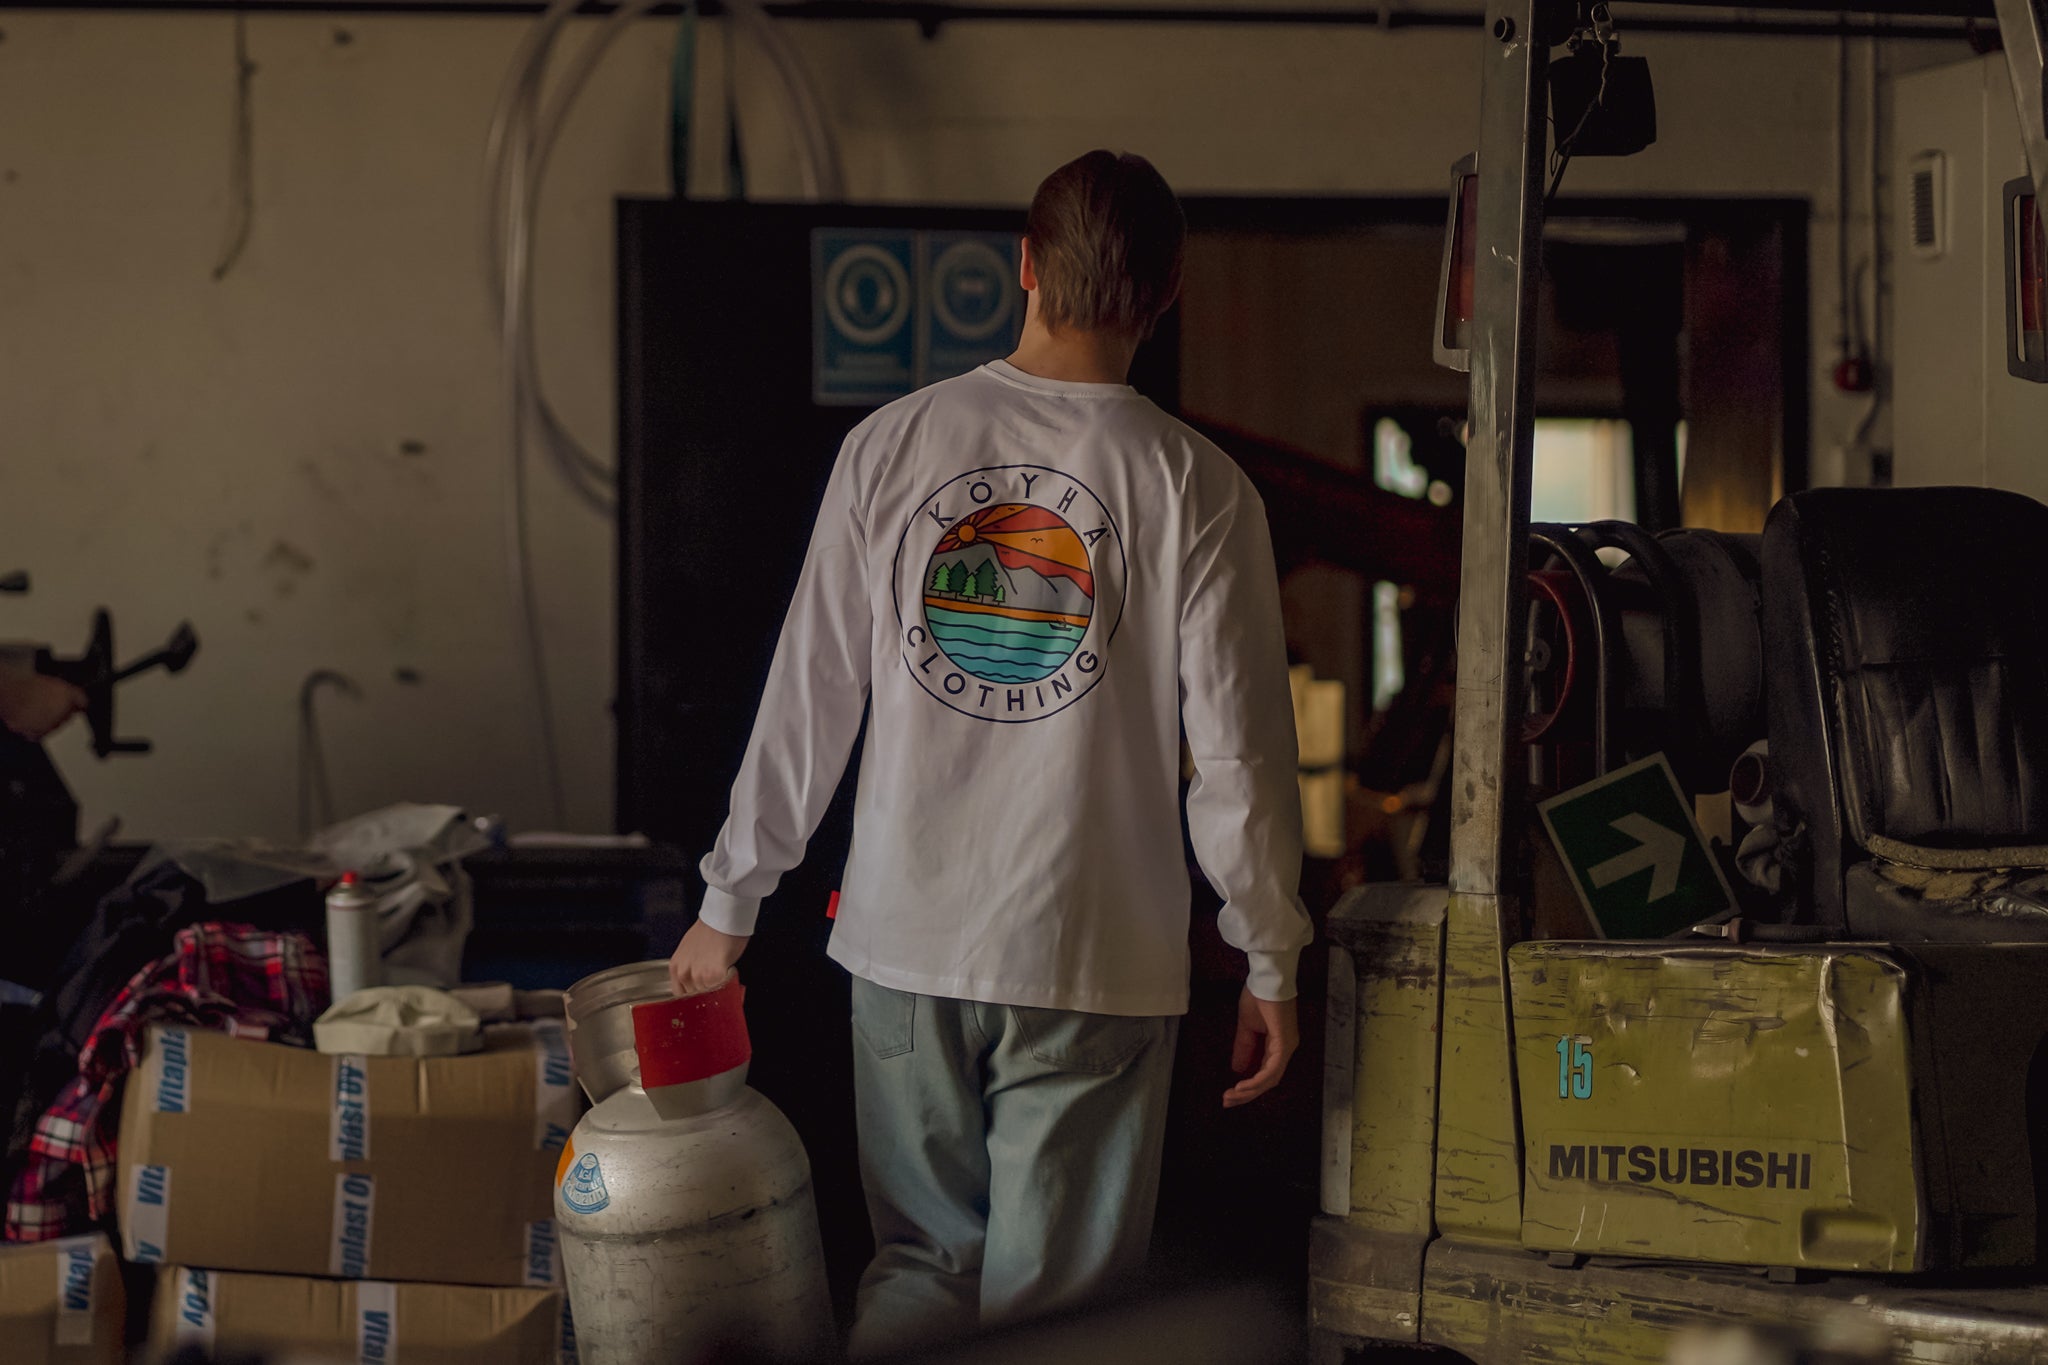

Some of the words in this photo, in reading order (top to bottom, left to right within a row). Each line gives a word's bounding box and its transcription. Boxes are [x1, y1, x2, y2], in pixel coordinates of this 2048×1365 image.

[927, 472, 1111, 547] KÖYHÄ
[906, 625, 1099, 712] CLOTHING
[1556, 1034, 1594, 1099] 15
[1549, 1144, 1811, 1191] MITSUBISHI
